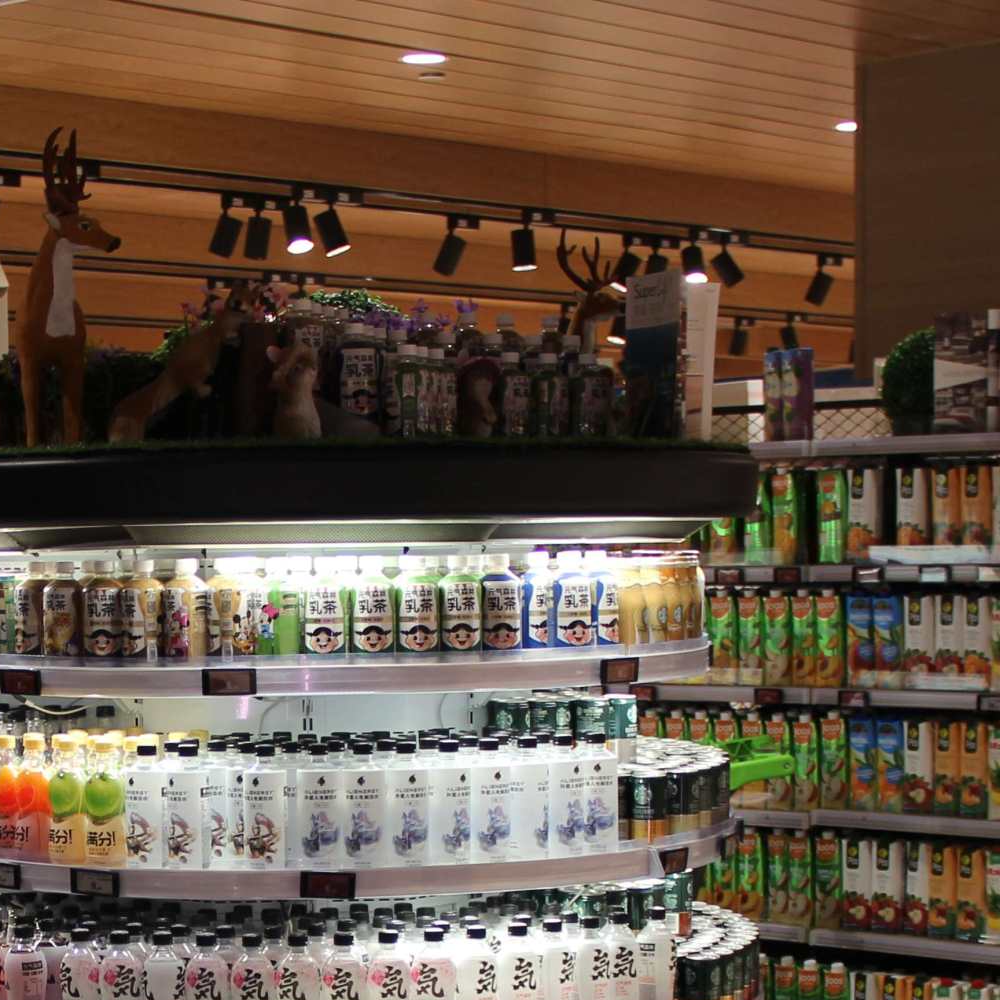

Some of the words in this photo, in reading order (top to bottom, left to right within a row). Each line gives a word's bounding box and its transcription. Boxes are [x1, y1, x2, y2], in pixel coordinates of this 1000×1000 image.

[310, 601, 336, 614] 乳茶
[359, 599, 386, 614] 乳茶
[405, 599, 432, 613] 乳茶
[447, 597, 475, 612] 乳茶
[488, 597, 516, 612] 乳茶
[564, 594, 589, 608] 乳茶
[87, 603, 114, 616] 乳茶
